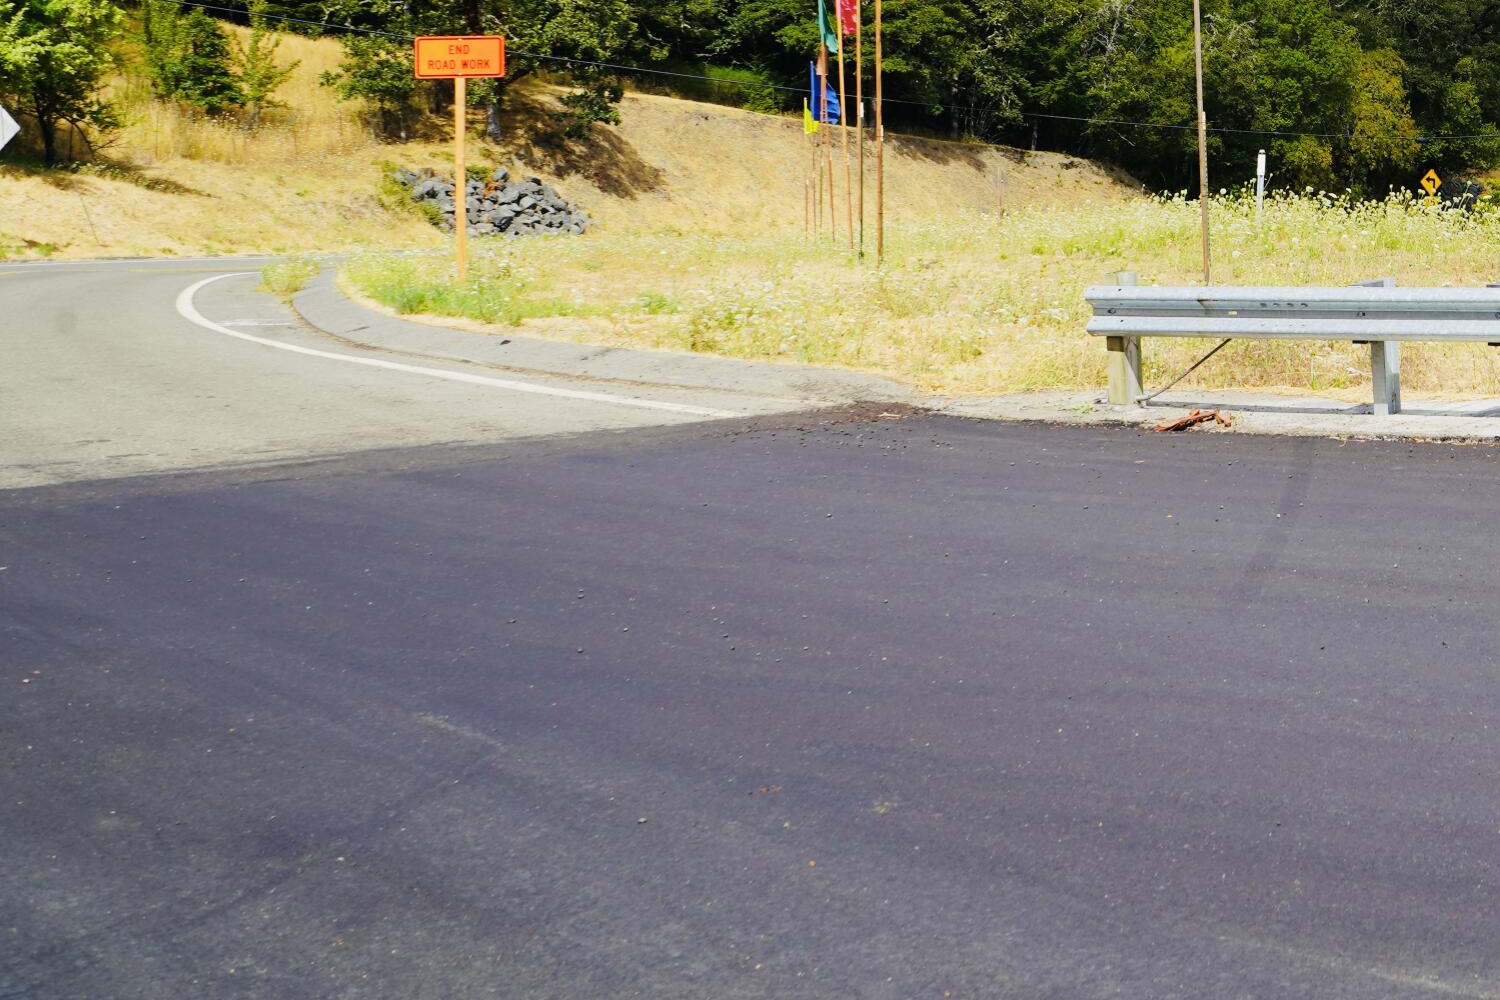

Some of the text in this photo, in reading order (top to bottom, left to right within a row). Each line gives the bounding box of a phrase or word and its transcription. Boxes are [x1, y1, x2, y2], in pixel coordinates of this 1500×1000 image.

[448, 45, 470, 54] END
[427, 59, 491, 70] ROAD WORK
